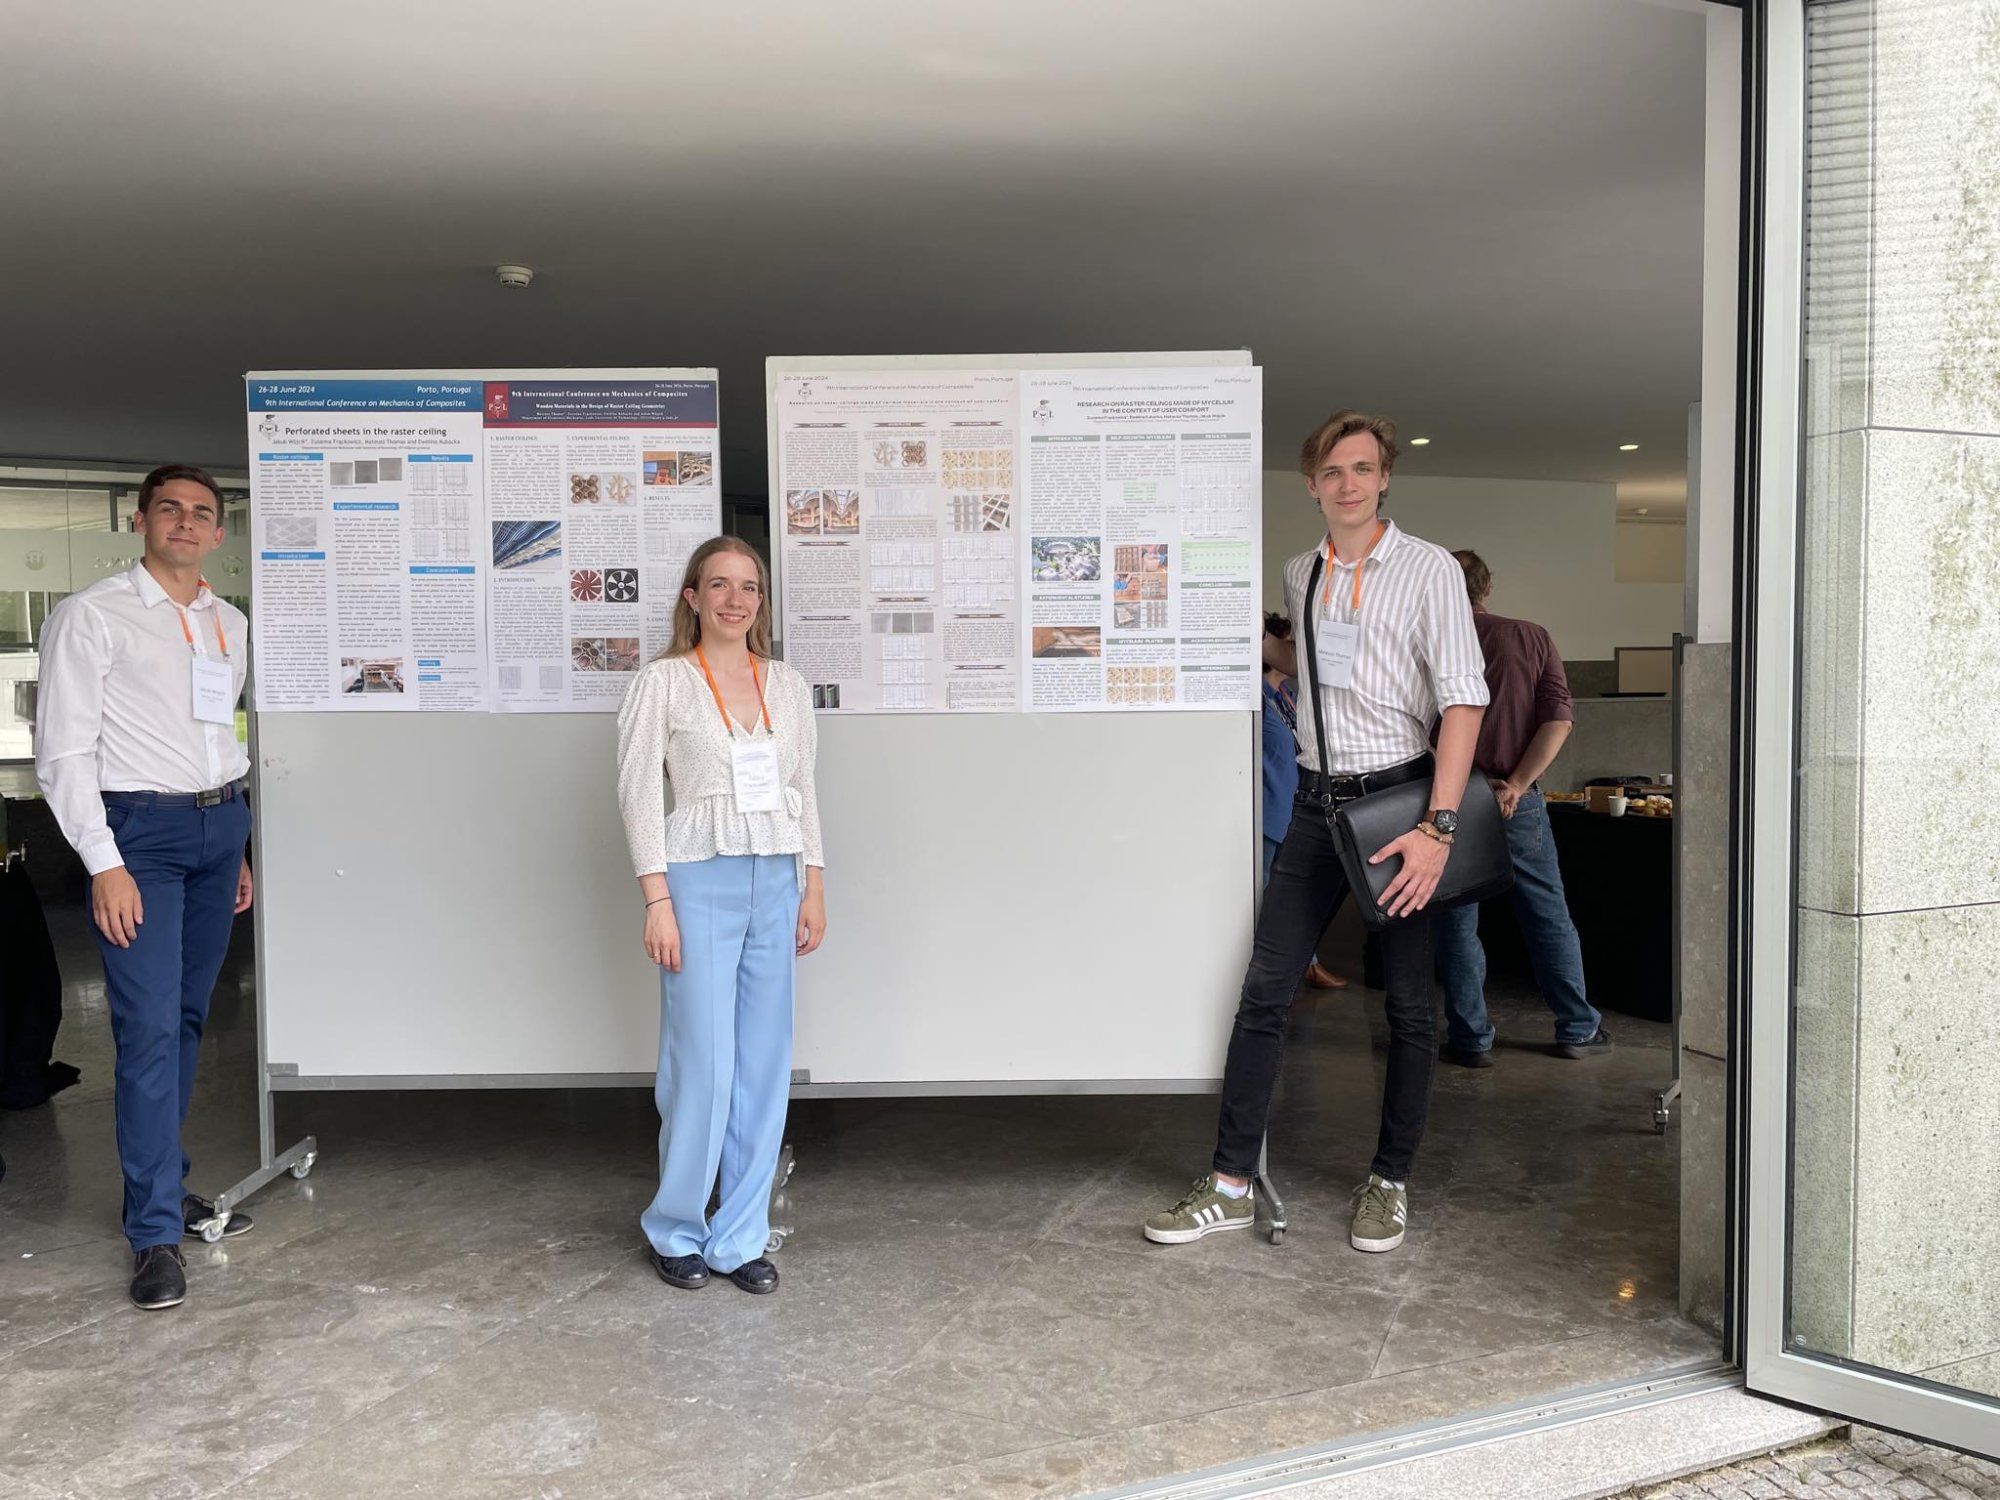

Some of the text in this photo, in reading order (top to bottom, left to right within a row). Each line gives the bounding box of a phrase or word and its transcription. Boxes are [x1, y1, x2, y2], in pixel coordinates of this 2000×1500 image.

[417, 386, 471, 395] Porto, Portugal
[327, 399, 367, 408] Conference
[416, 400, 424, 408] of
[426, 400, 466, 408] Composites
[286, 427, 330, 435] Perforated
[333, 427, 360, 435] sheets
[419, 428, 447, 437] ceiling
